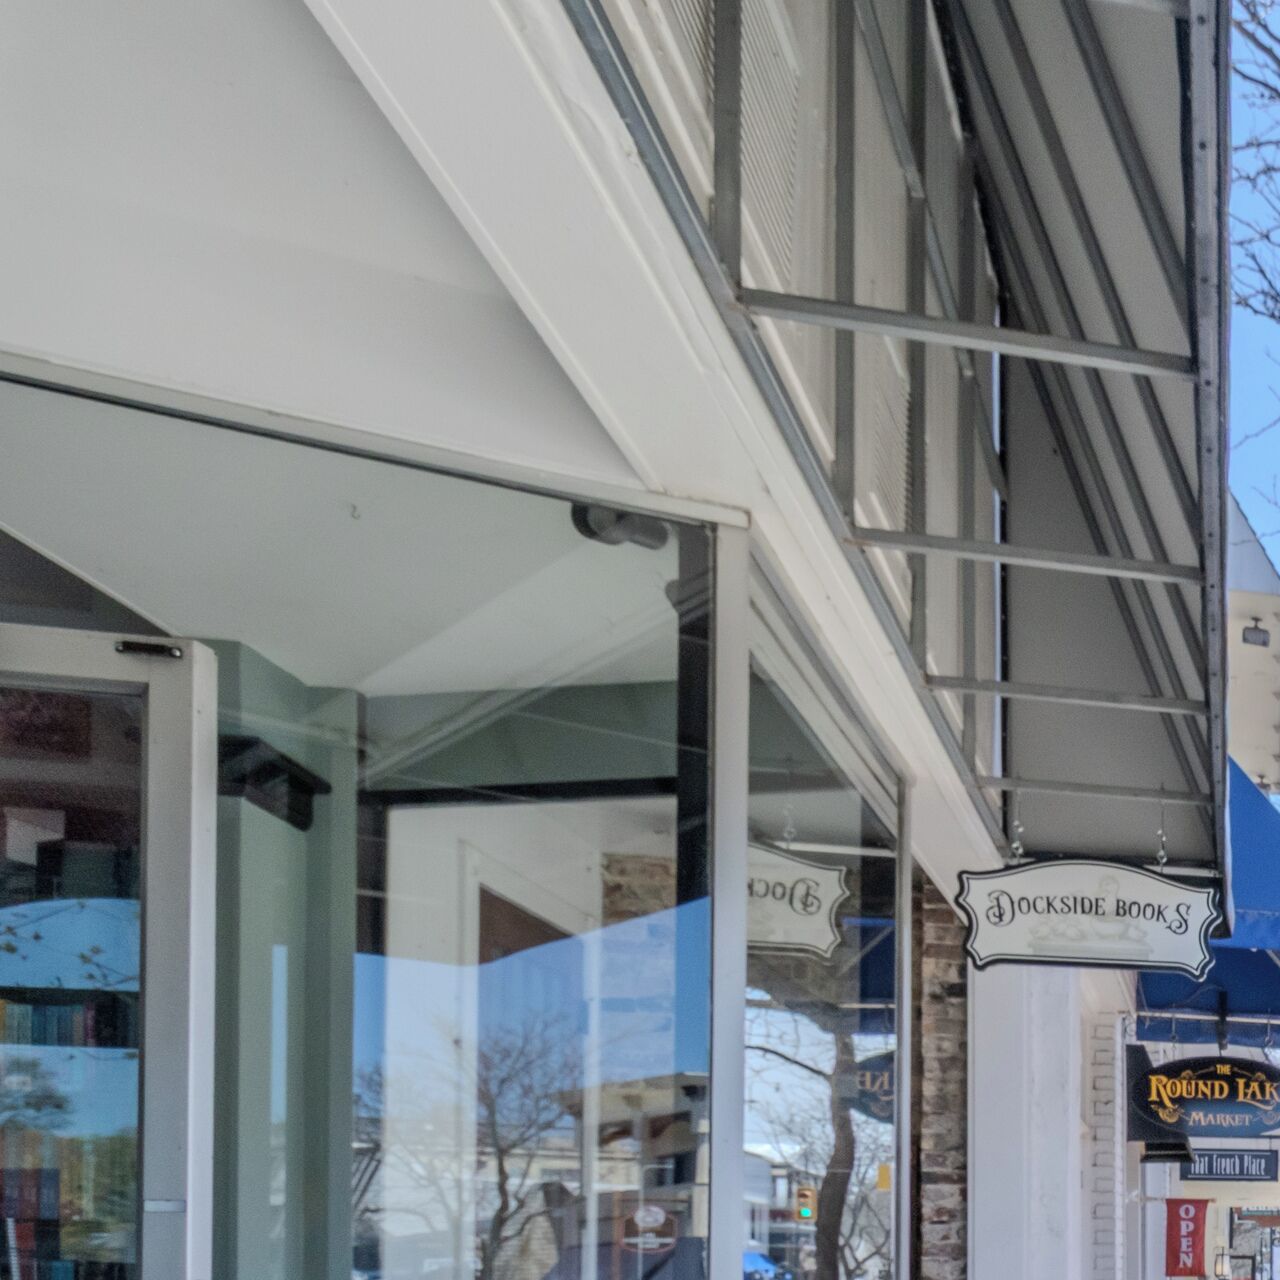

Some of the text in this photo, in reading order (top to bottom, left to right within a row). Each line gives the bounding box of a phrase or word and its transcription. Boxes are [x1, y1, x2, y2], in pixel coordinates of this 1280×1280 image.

[985, 889, 1192, 935] DOCKSIDE BOOKS
[1216, 1064, 1232, 1076] THE
[1148, 1074, 1230, 1109] ROUND
[1188, 1110, 1253, 1127] MARKET
[1212, 1154, 1241, 1176] French
[1243, 1154, 1267, 1176] Place
[1178, 1204, 1196, 1268] OPEN
